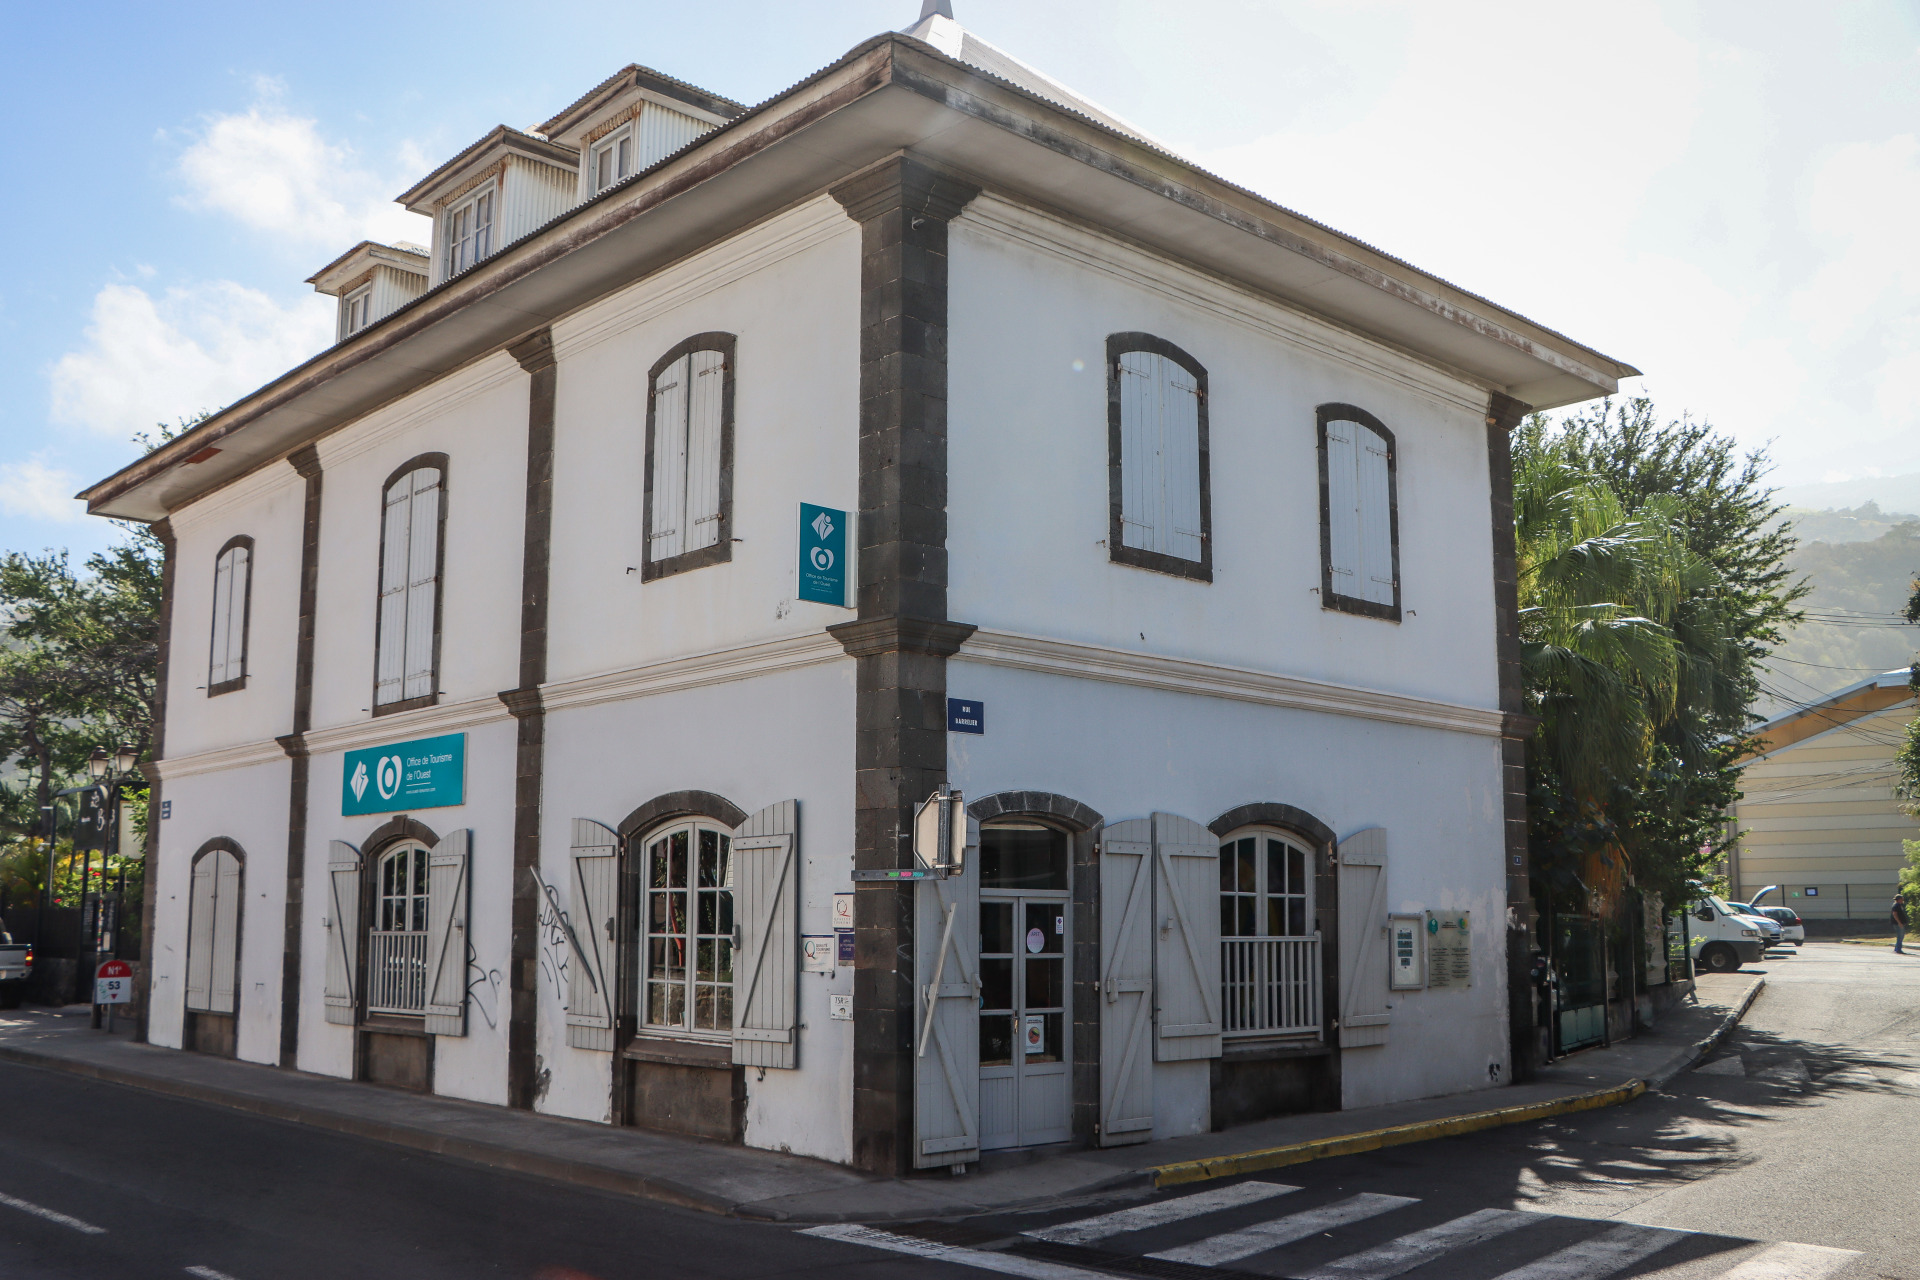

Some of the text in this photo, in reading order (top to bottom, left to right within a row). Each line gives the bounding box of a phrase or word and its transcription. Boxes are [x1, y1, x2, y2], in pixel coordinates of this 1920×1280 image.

[406, 754, 453, 767] Office de Tourisme
[406, 769, 431, 780] de l'Ouest
[108, 981, 121, 990] 53
